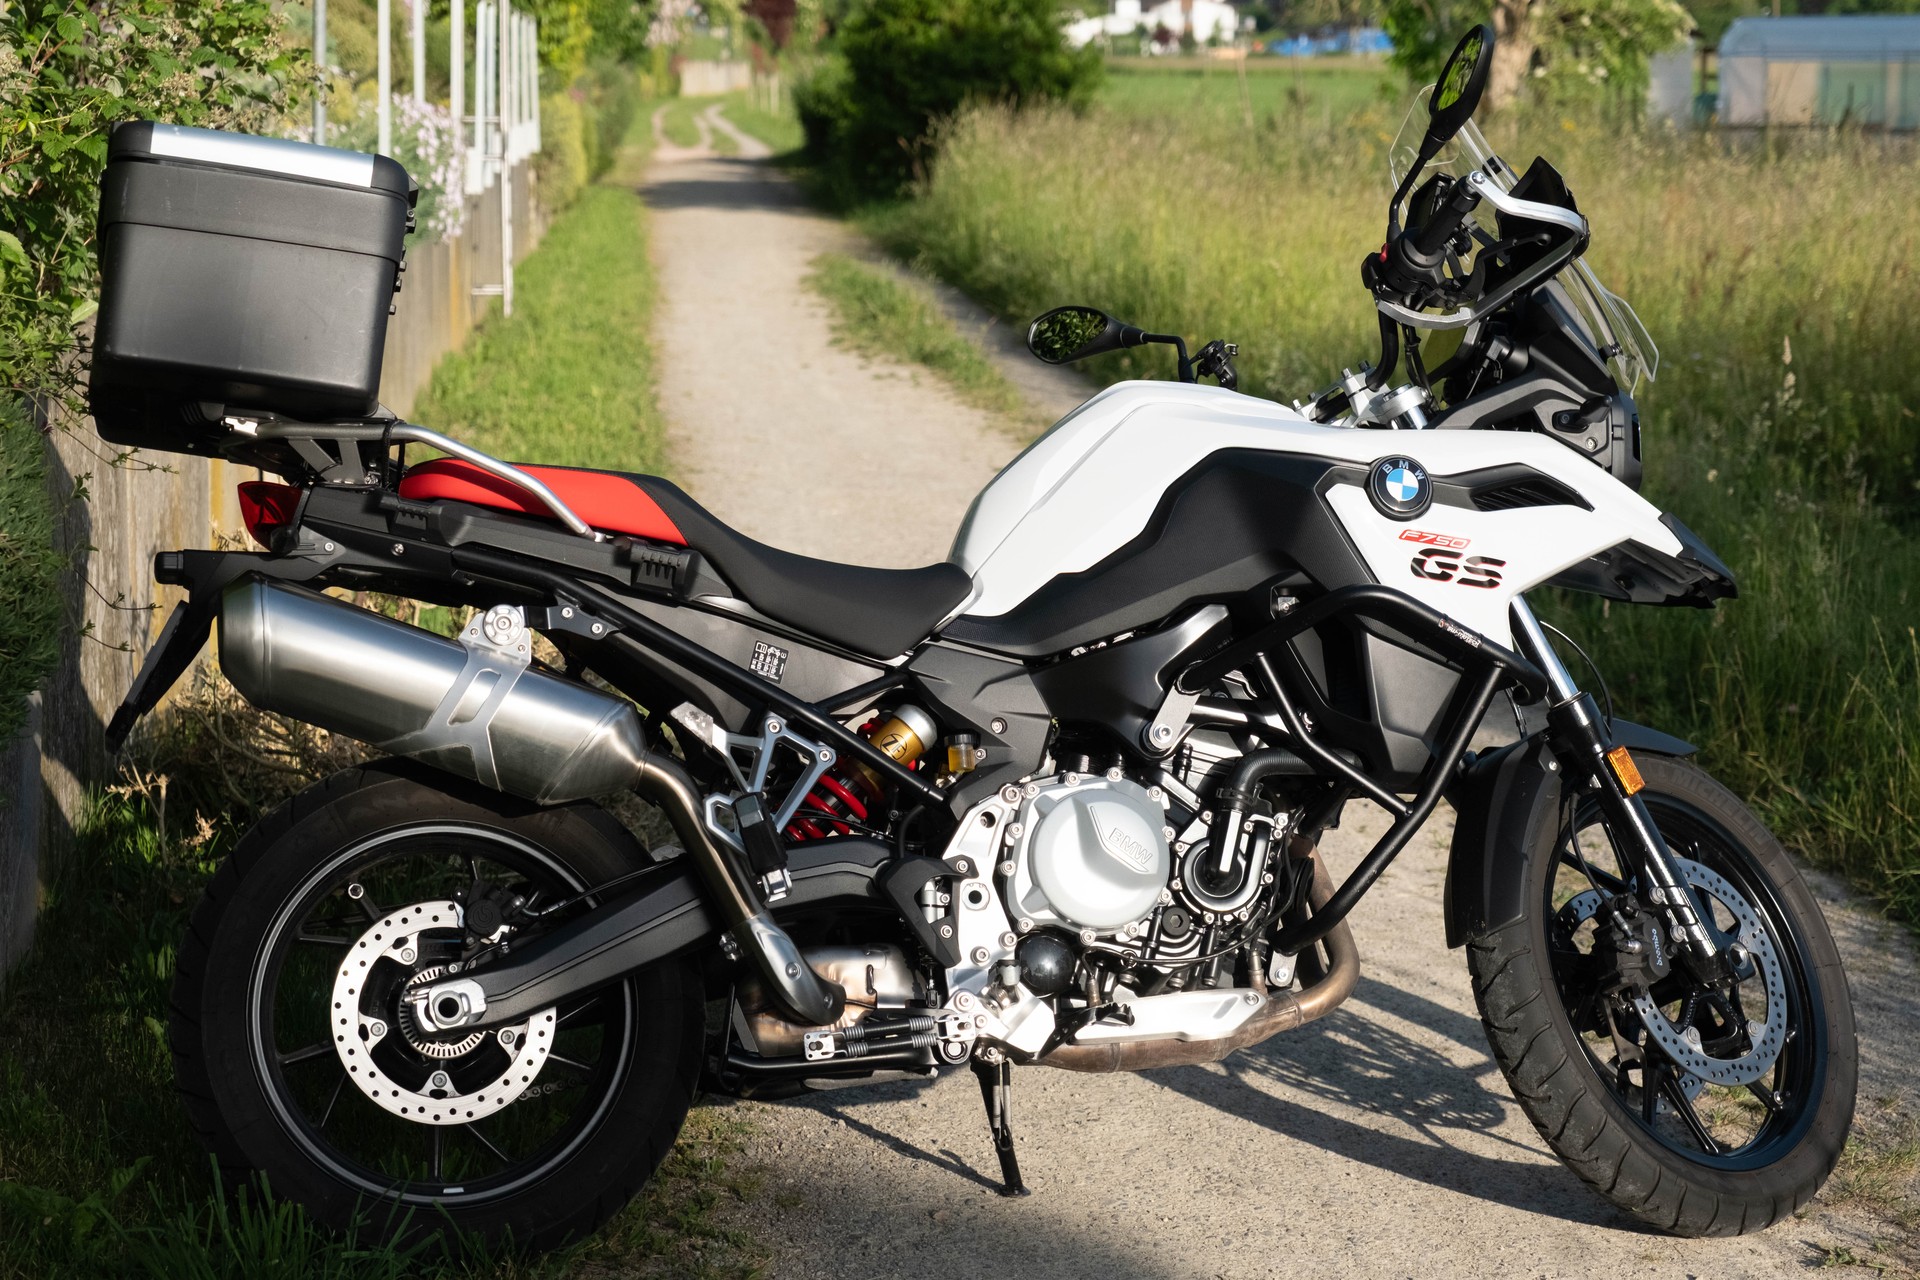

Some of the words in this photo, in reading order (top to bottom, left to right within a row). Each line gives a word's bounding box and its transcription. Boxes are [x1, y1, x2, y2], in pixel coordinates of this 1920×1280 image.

[1382, 460, 1425, 481] BMW
[1411, 547, 1506, 589] GS
[1108, 828, 1153, 864] BMW
